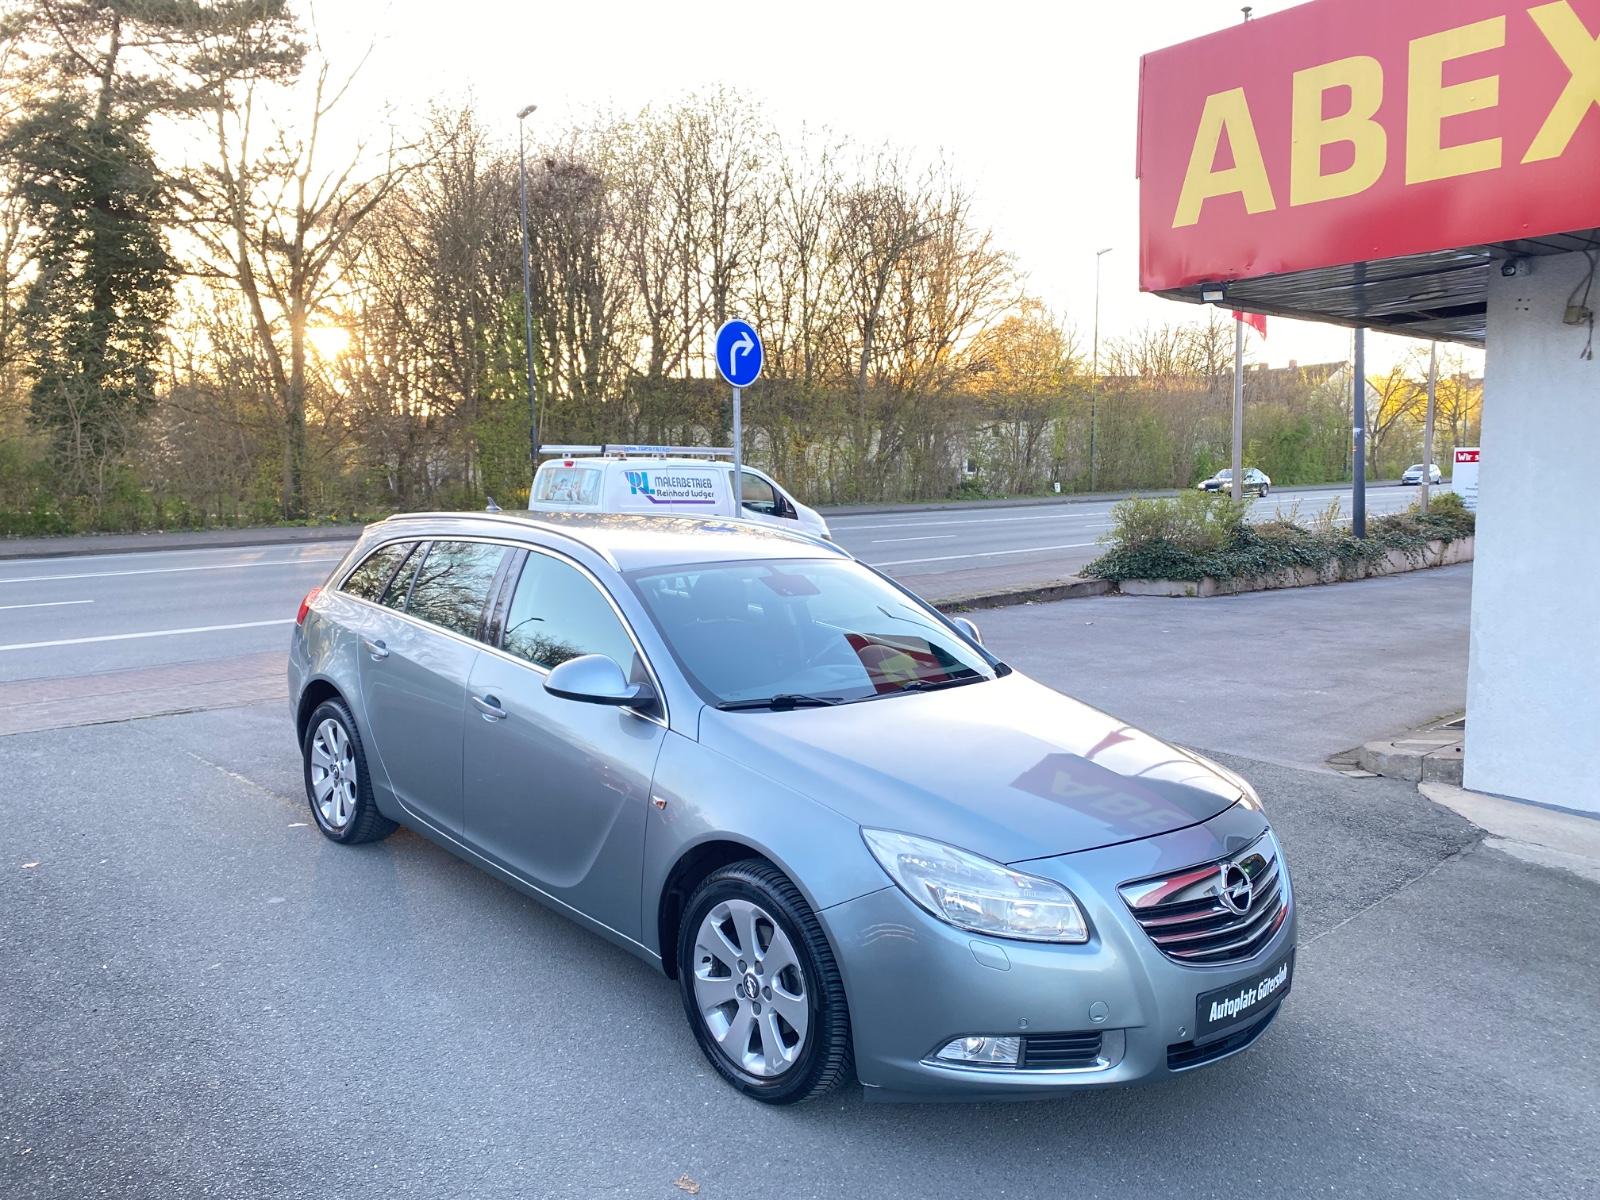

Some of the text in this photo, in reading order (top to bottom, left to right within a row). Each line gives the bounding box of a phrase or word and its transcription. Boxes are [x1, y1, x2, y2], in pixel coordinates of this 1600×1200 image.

[656, 488, 714, 499] Reinhard Ludger
[1208, 962, 1288, 1022] Autoplatz Gütersloh
